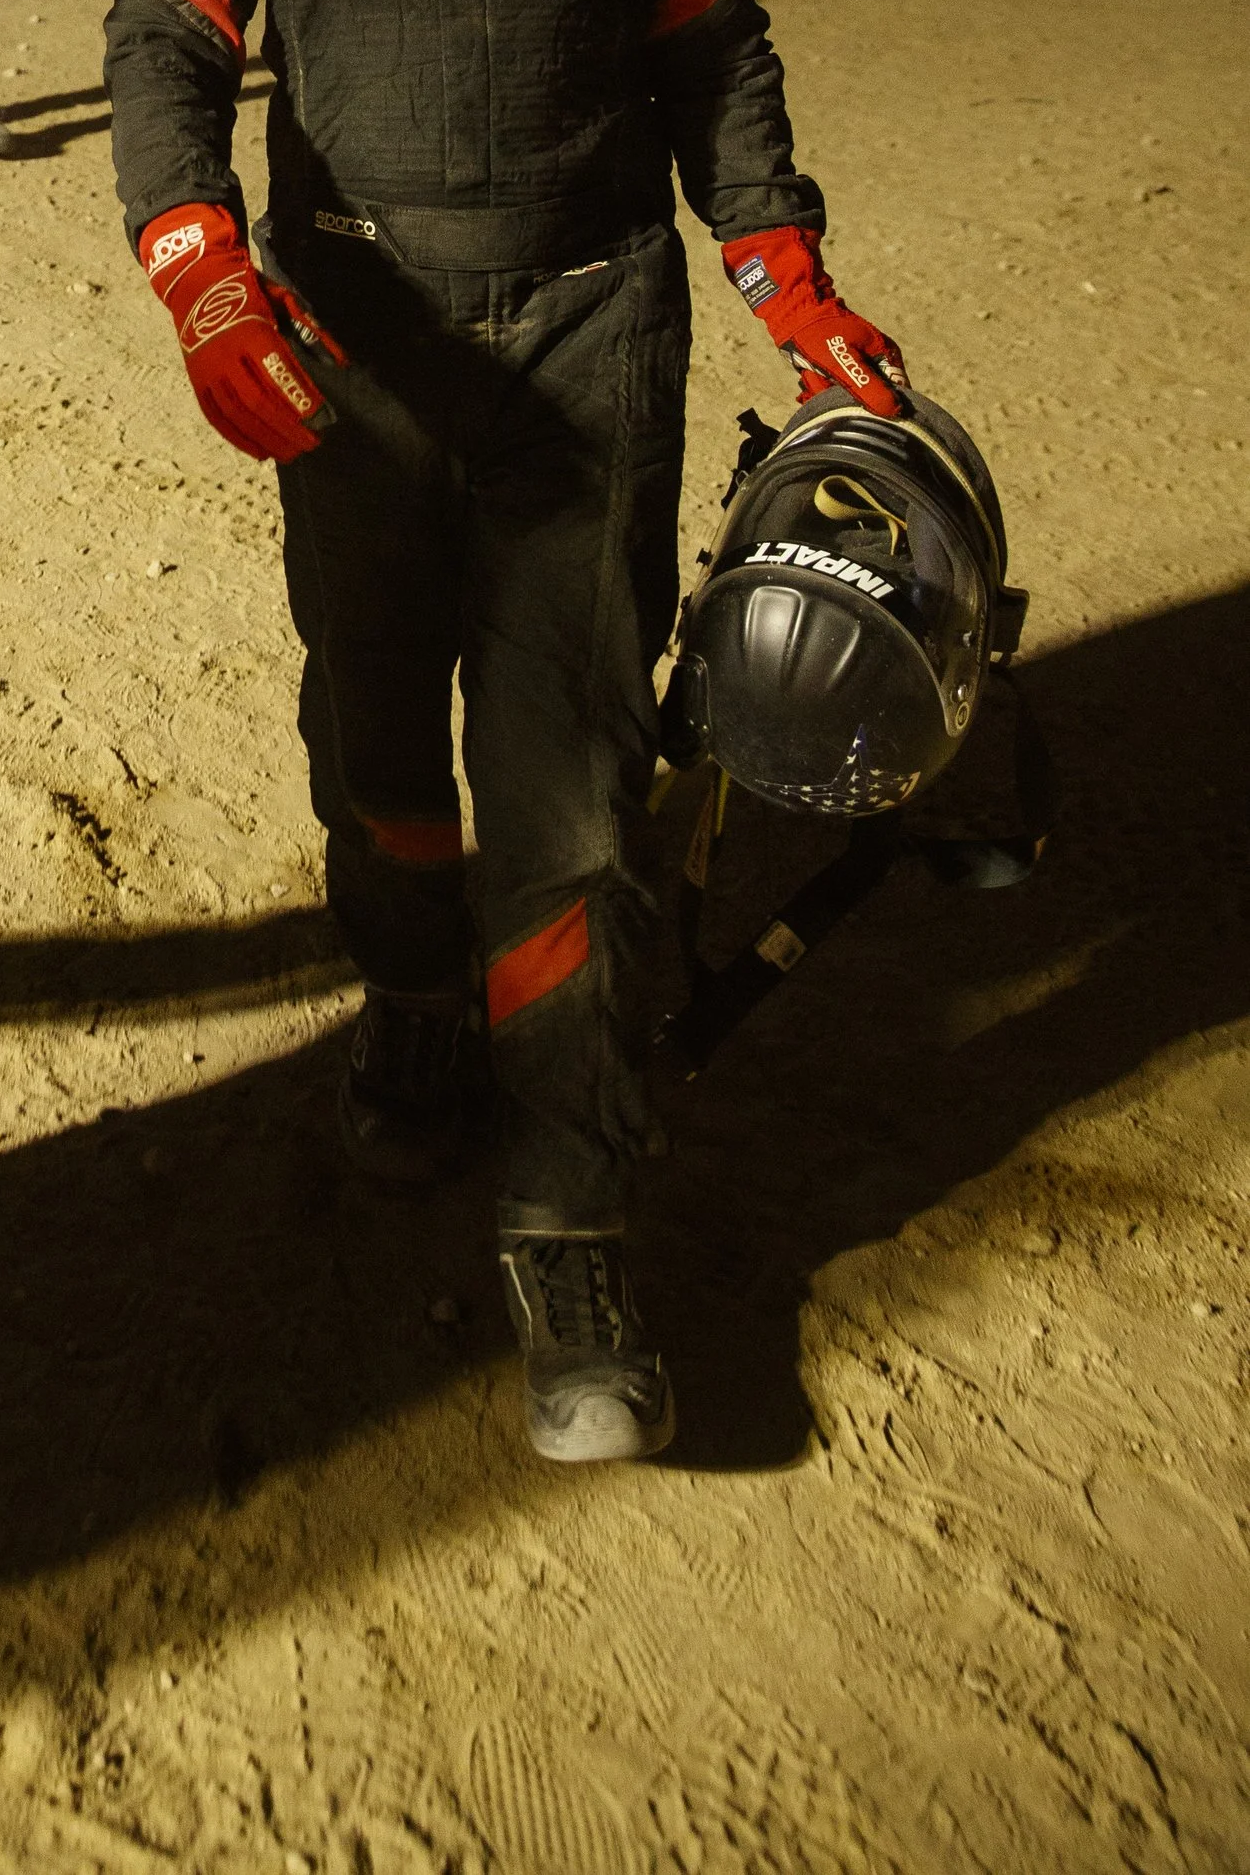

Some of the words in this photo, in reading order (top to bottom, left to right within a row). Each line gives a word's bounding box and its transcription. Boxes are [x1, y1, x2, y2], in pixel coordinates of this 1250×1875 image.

[313, 209, 376, 241] sparco
[262, 351, 312, 415] sparco
[826, 335, 870, 390] sparco
[744, 541, 895, 600] IMPACT
